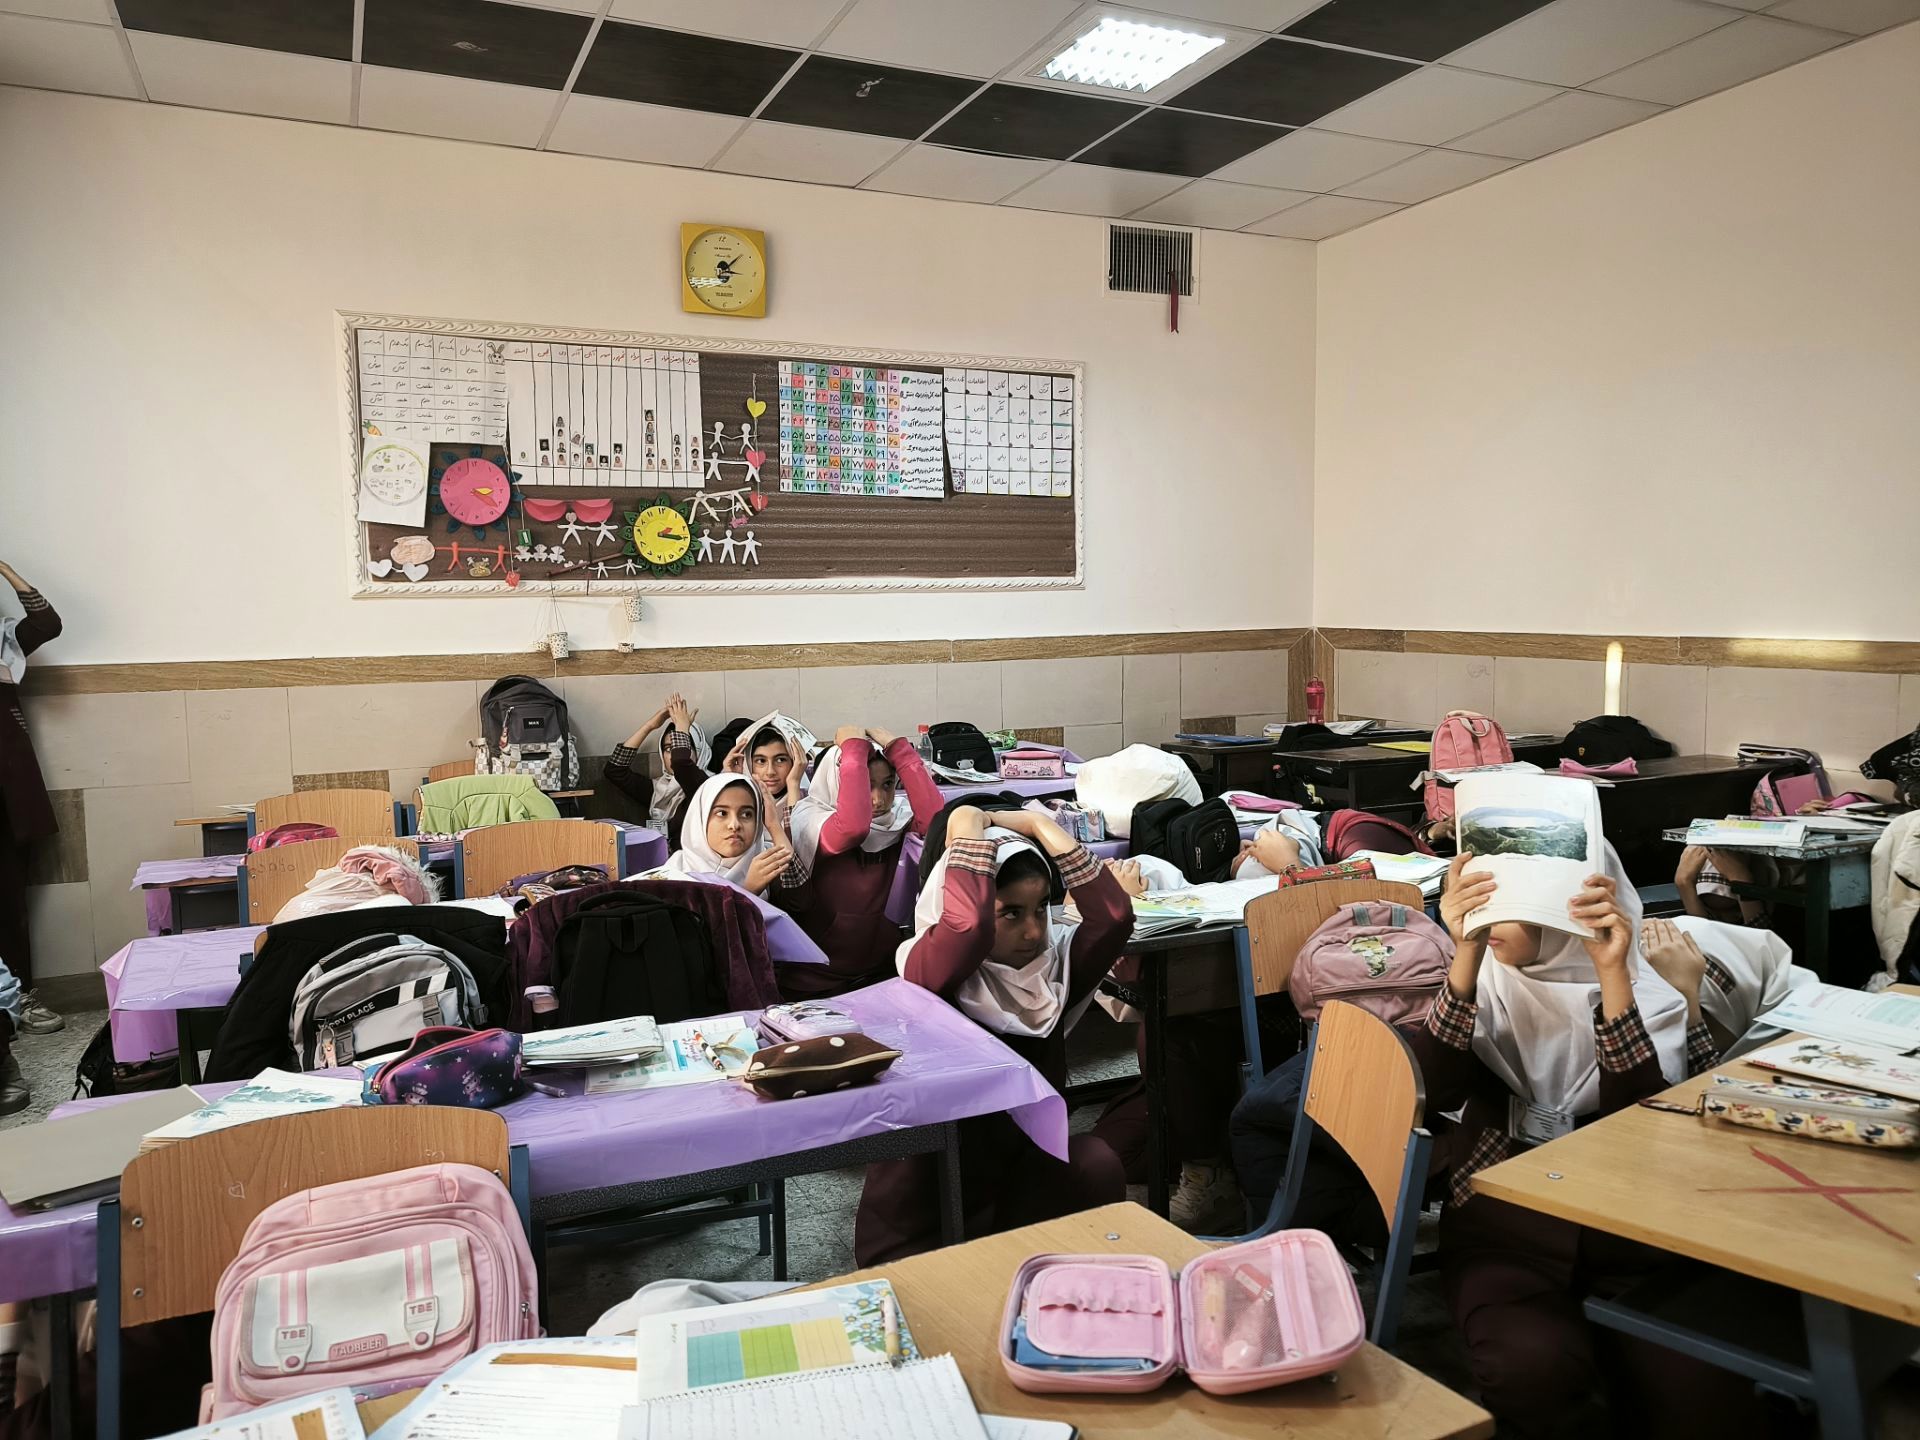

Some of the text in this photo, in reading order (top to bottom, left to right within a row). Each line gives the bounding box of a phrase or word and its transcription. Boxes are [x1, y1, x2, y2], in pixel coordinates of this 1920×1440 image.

[346, 1002, 376, 1020] PLACE
[409, 1302, 433, 1315] TBE
[281, 1328, 306, 1340] TBE
